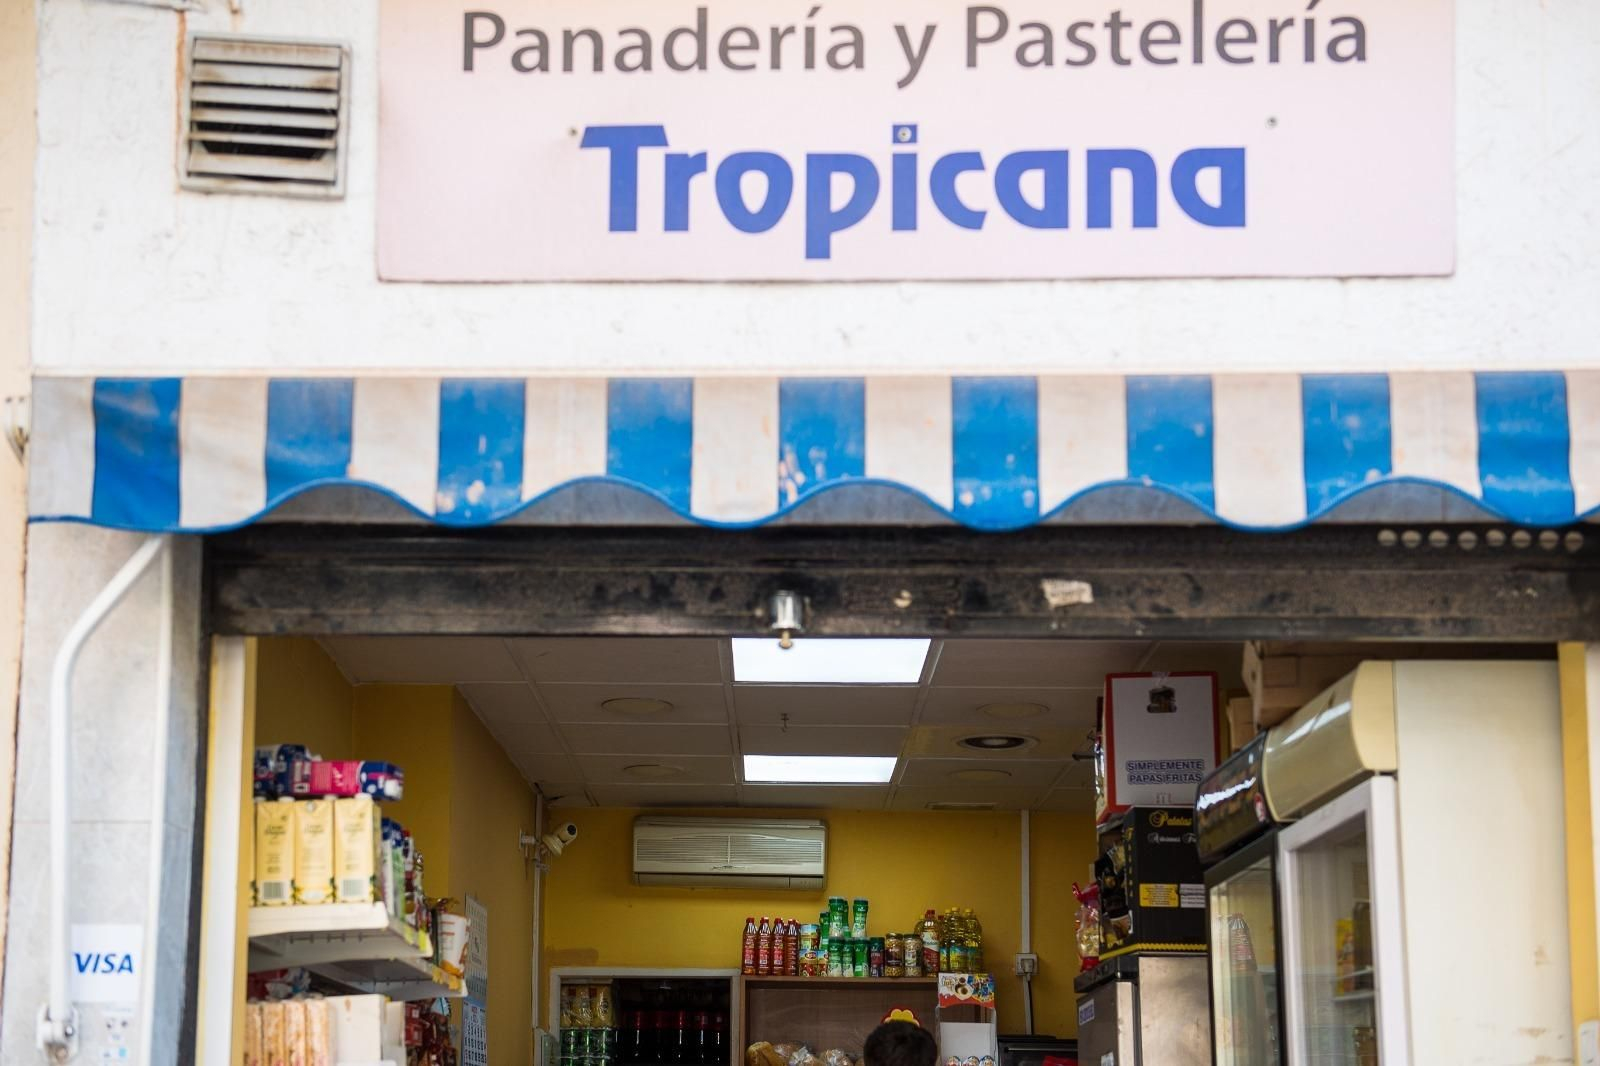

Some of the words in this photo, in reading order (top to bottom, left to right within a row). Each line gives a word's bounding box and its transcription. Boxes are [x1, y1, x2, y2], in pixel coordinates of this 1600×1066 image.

[462, 6, 866, 74] Panadería
[894, 23, 937, 90] y
[965, 0, 1368, 69] Pastelería
[579, 123, 1247, 260] Tropicana
[1127, 760, 1204, 771] SIMPLEMENTE
[1129, 773, 1163, 784] PAPAS
[1165, 772, 1202, 783] FRITAS
[74, 953, 134, 974] VISA
